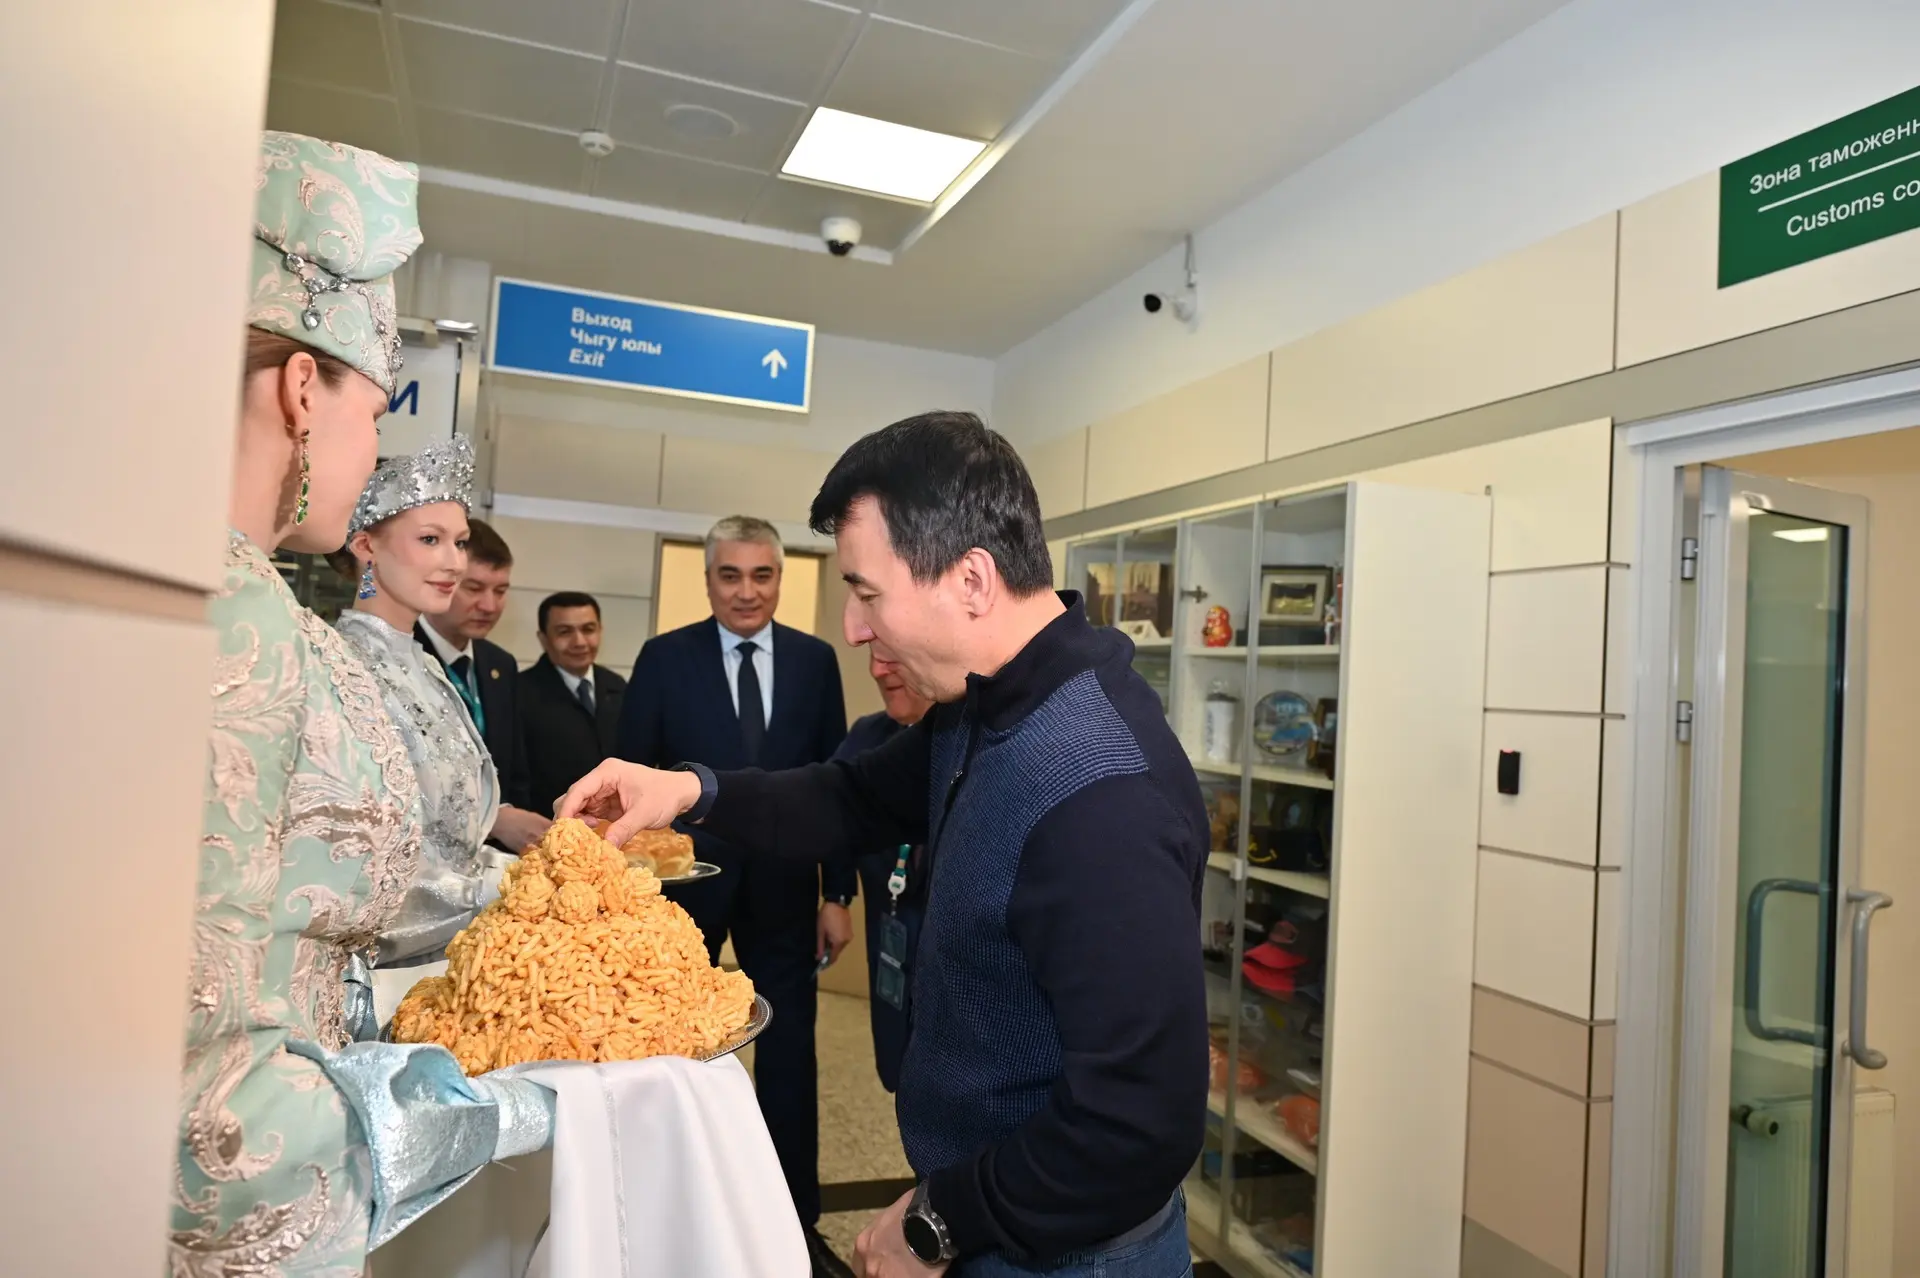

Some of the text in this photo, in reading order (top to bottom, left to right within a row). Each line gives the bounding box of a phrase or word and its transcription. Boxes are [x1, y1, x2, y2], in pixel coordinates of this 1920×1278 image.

[1749, 163, 1801, 195] Зона
[1786, 179, 1920, 236] Customs co
[571, 307, 632, 332] Выход
[570, 328, 662, 356] Чыгу юлы
[569, 348, 605, 367] Exit
